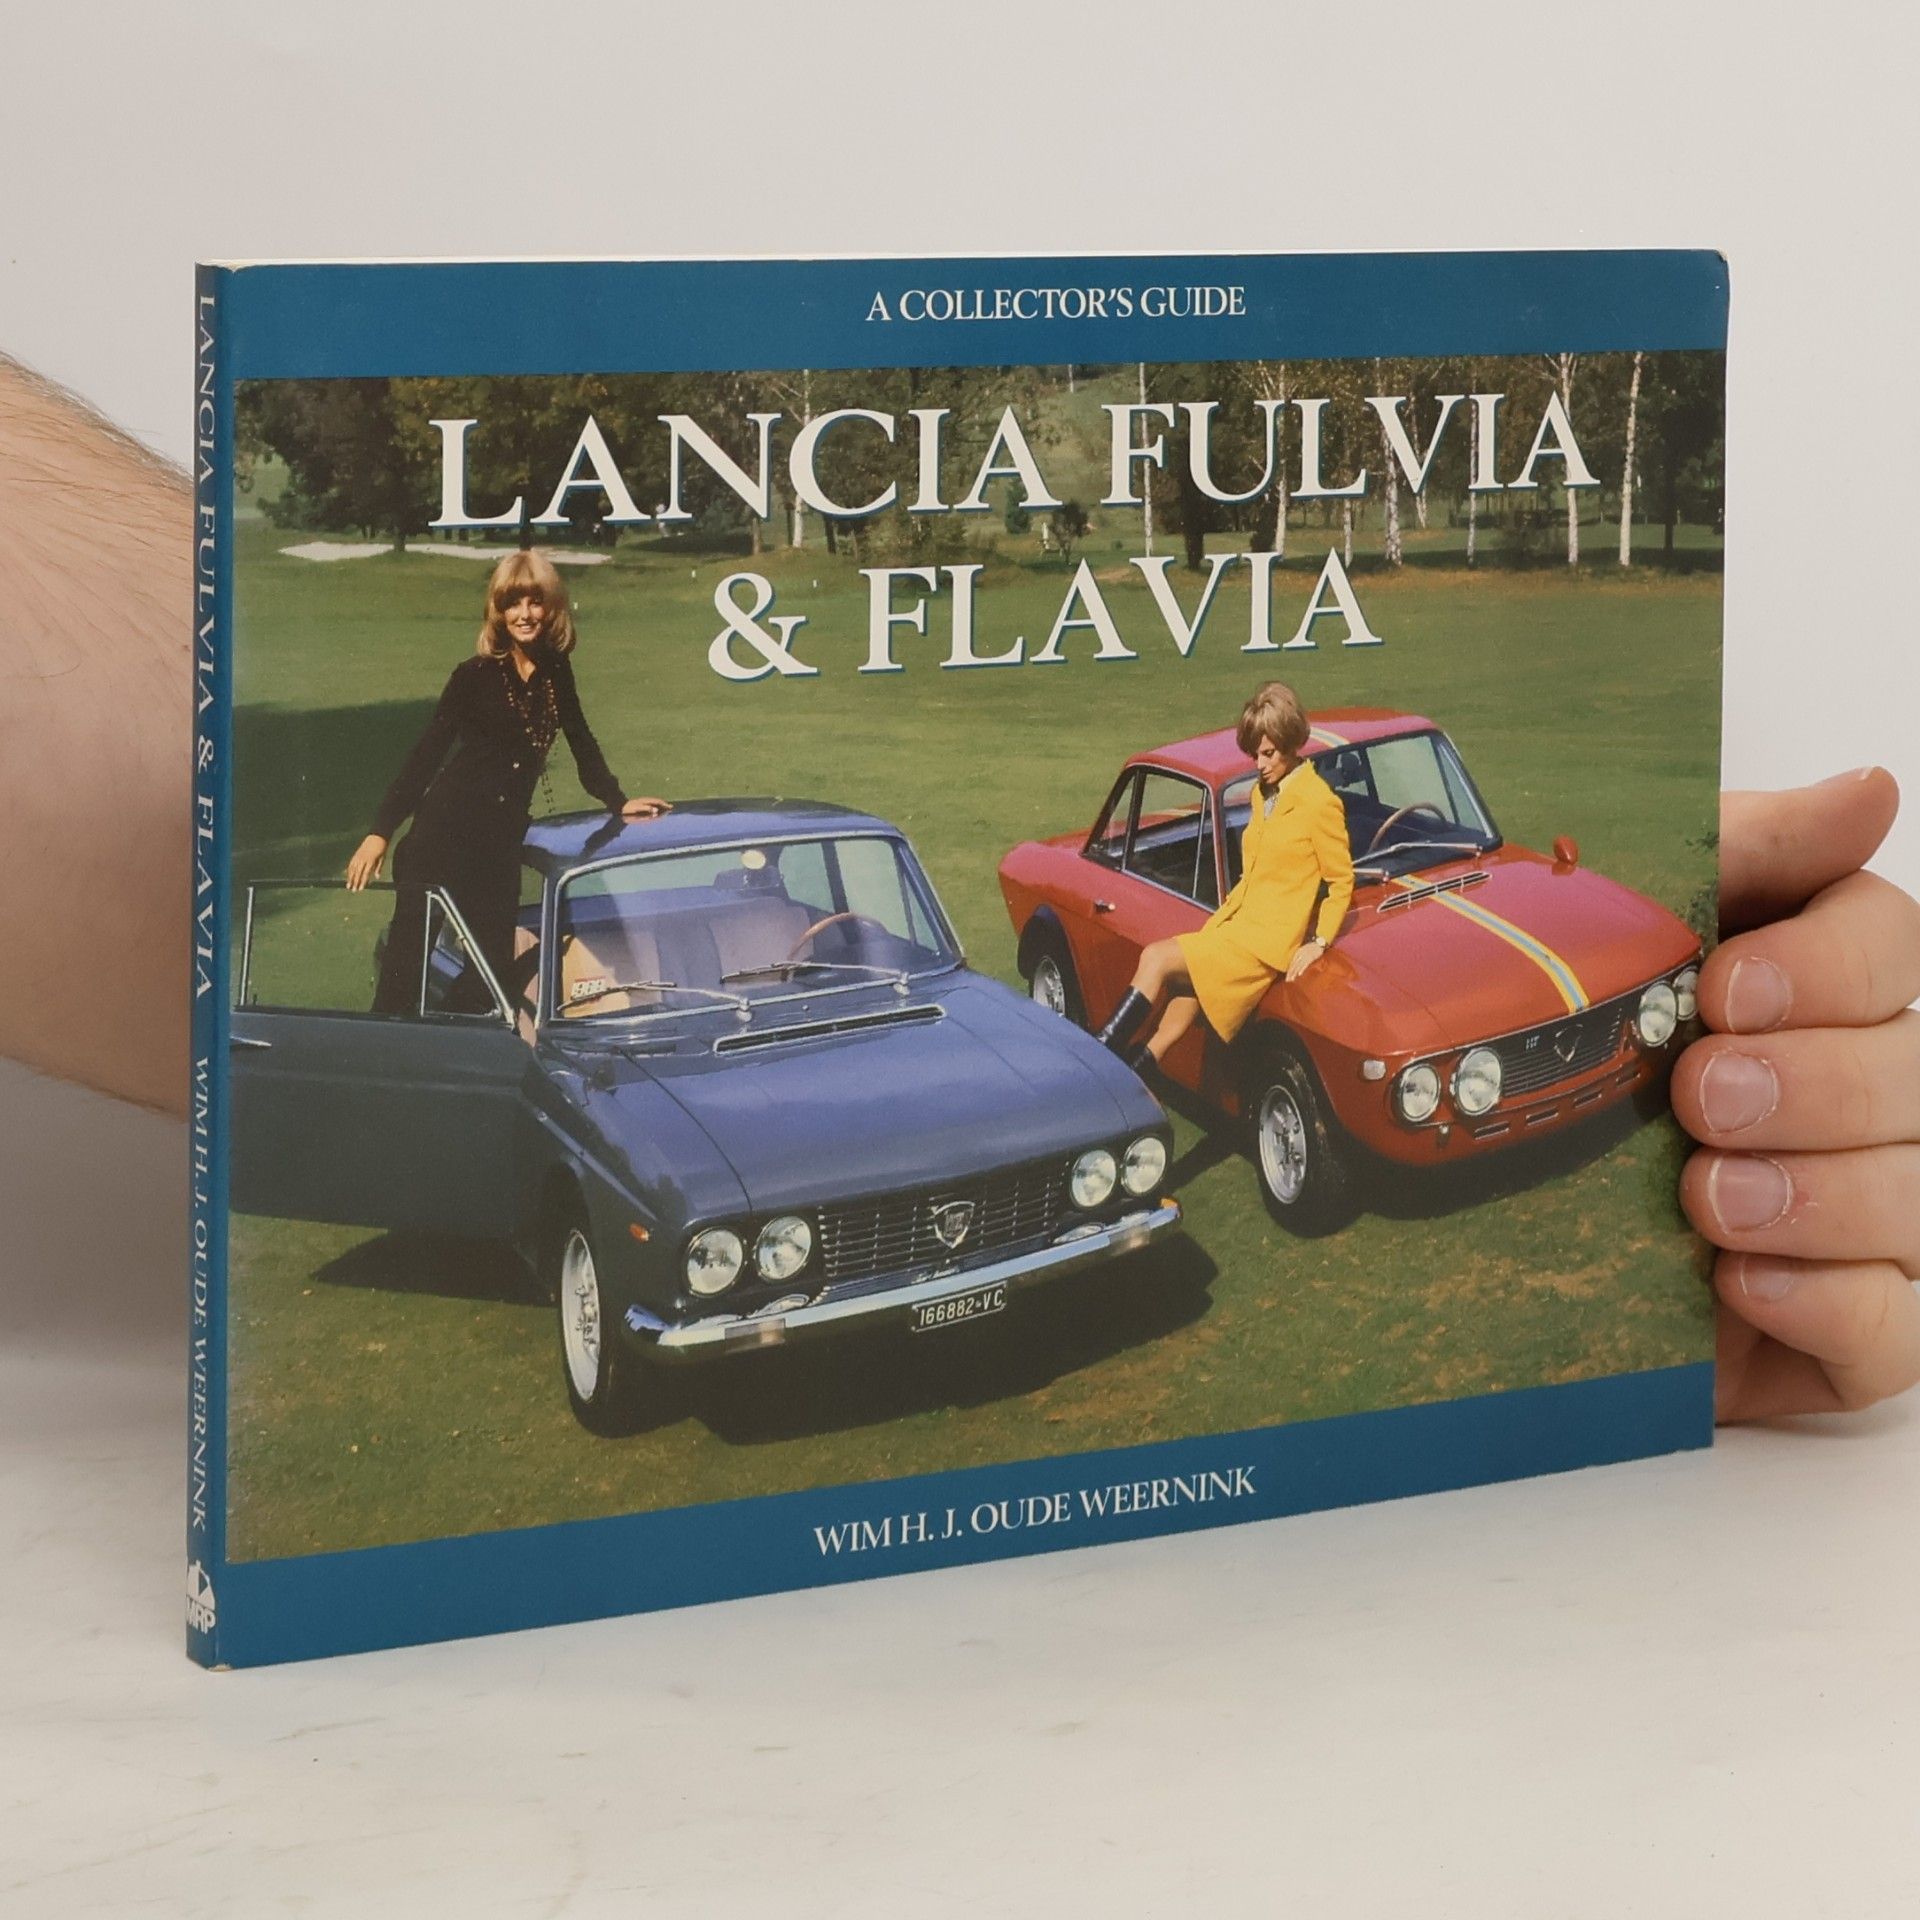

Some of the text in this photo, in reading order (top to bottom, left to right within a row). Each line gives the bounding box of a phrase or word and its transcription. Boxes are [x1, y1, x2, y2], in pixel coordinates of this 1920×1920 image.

[865, 286, 1247, 322] A COLLECTOR'S GUIDE
[428, 391, 1600, 527] LANCIA FULVIA
[196, 295, 215, 998] LANCIA FULVIA & FLAVIA
[707, 547, 1383, 681] & FLAVIA
[193, 1057, 209, 1532] WIM H. J. OUDE WEERNINK
[813, 1465, 1256, 1556] WIM H. J. OUDE WEERNINK
